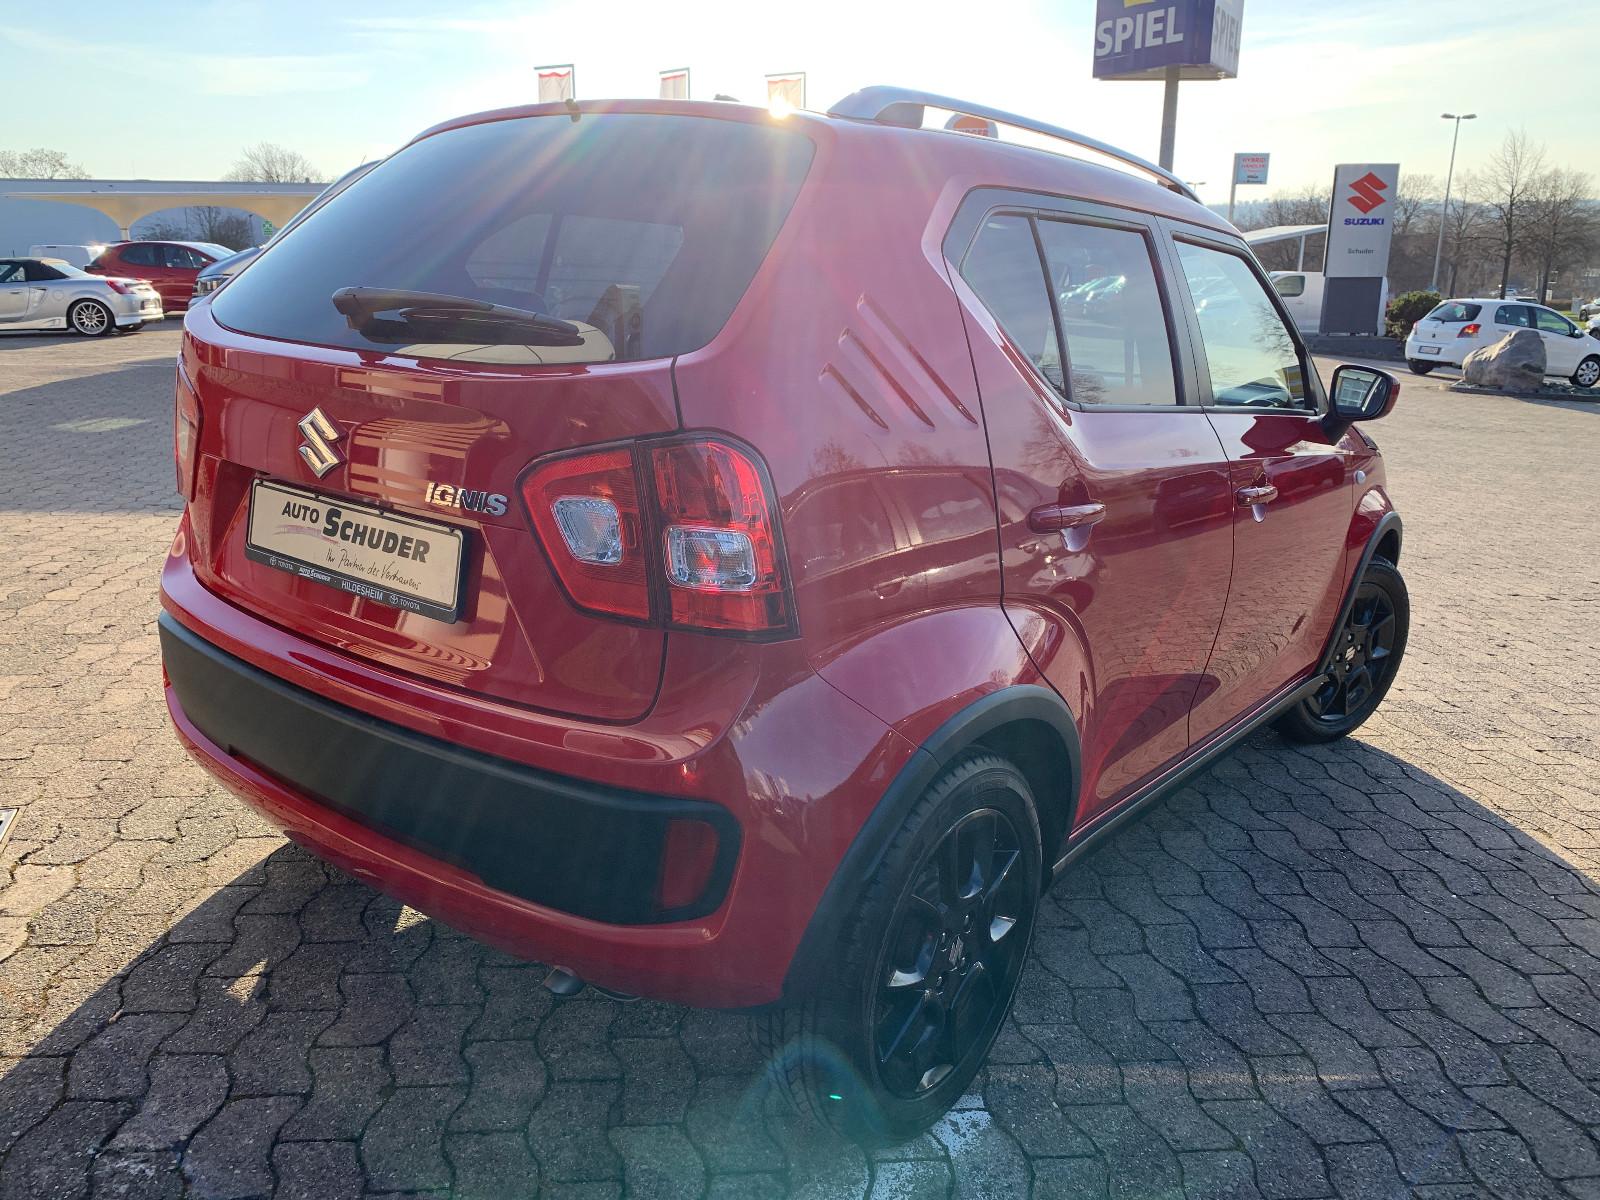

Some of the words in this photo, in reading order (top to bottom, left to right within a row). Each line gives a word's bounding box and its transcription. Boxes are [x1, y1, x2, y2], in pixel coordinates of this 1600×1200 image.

[1095, 6, 1184, 57] SPIEL
[1344, 217, 1385, 225] SUZUKI
[424, 482, 508, 516] IGNIS
[281, 501, 320, 524] AUTO
[322, 507, 430, 563] SCHUDER
[277, 560, 293, 570] TOYOTA
[341, 580, 384, 600] HILDESHEIM
[399, 599, 420, 611] TOYOTA
